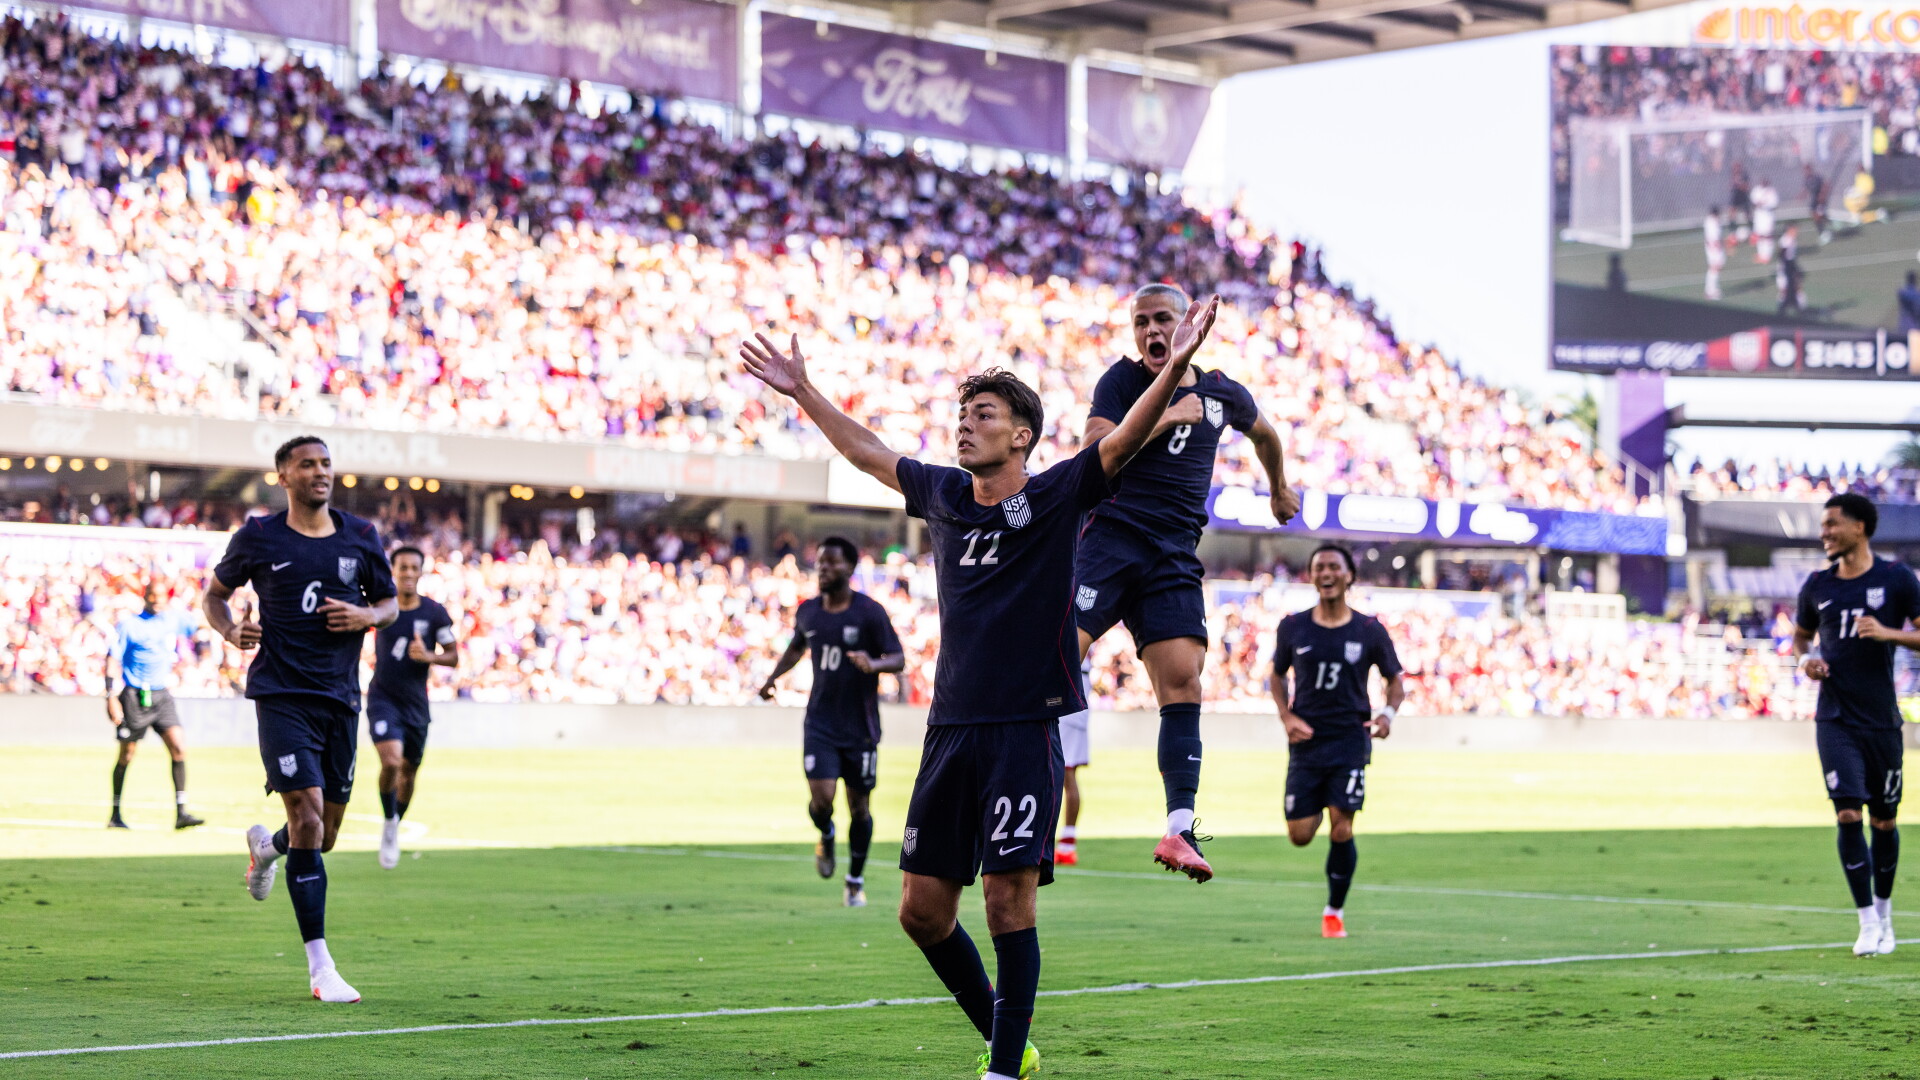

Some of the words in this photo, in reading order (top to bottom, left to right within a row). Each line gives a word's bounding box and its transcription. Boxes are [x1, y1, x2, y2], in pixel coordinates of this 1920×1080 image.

[862, 47, 970, 126] Ford
[1770, 339, 1796, 367] 0
[1886, 341, 1908, 369] 0
[1168, 424, 1192, 455] 8
[1003, 495, 1026, 512] USA
[959, 528, 1003, 566] 22
[301, 580, 322, 614] 6
[1839, 608, 1865, 639] 17
[391, 636, 409, 662] 4
[820, 644, 842, 671] 10
[1315, 662, 1342, 690] 13
[991, 794, 1037, 841] 22
